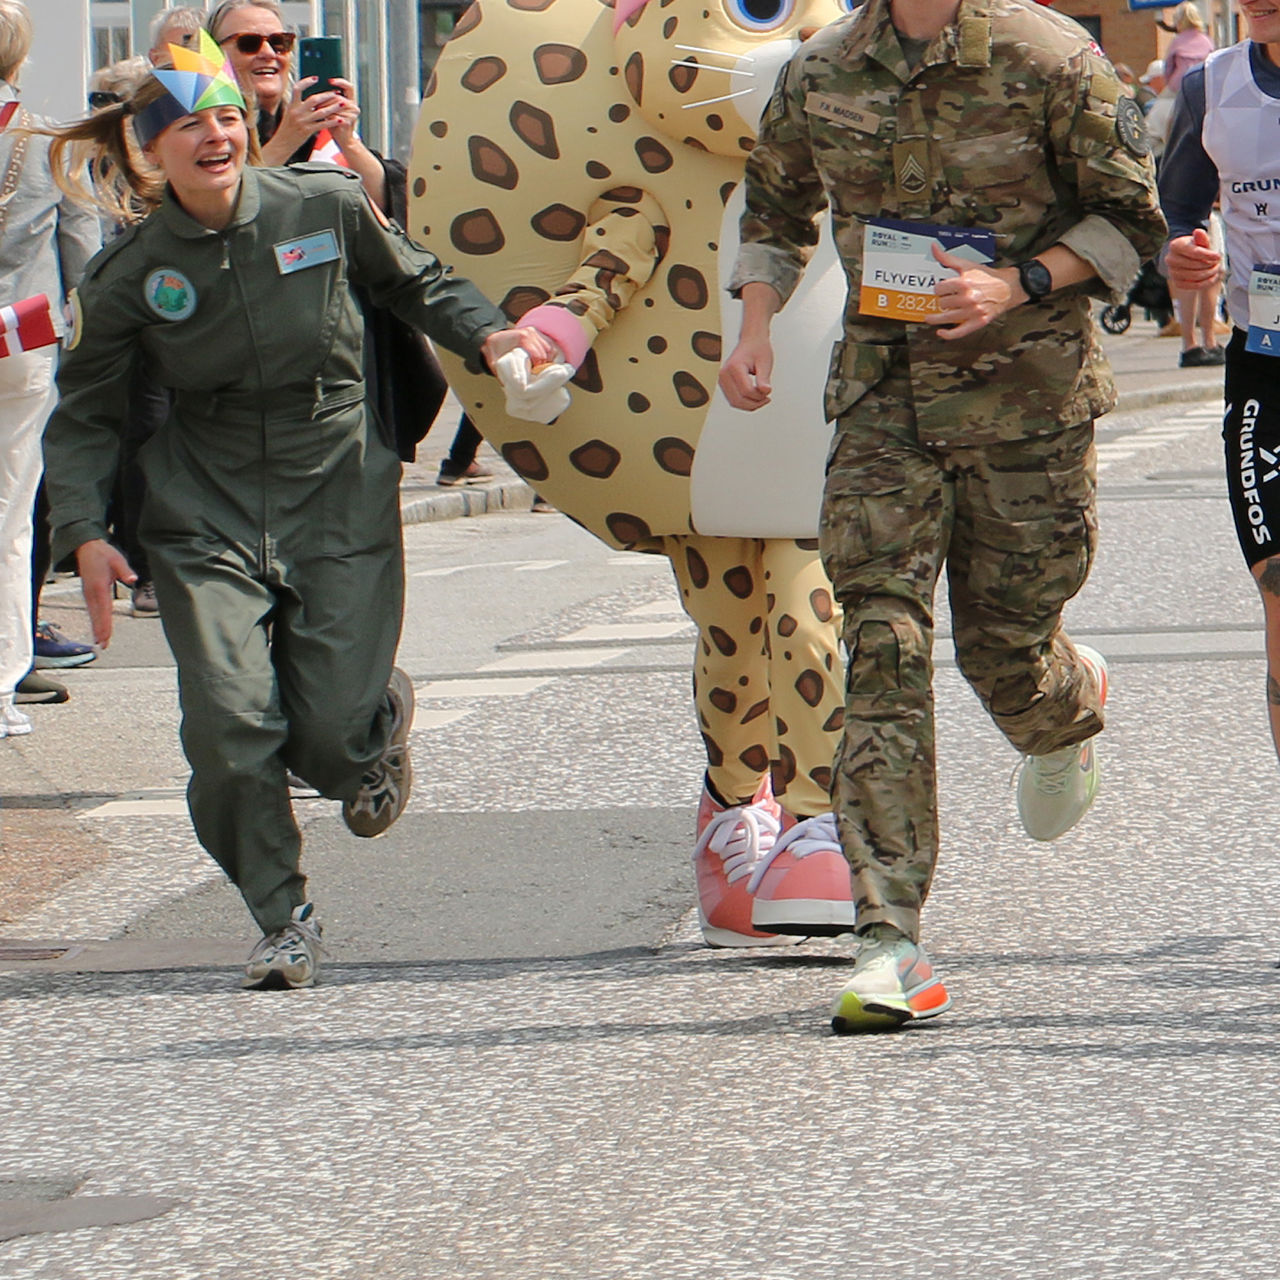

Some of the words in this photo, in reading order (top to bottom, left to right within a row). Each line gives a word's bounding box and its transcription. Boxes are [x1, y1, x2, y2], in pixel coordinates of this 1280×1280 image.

[832, 106, 864, 122] MADSEN
[875, 270, 945, 288] FLYVEVÅ
[878, 294, 888, 307] B
[1261, 334, 1272, 347] A
[1239, 398, 1272, 545] GRUNDFOS
